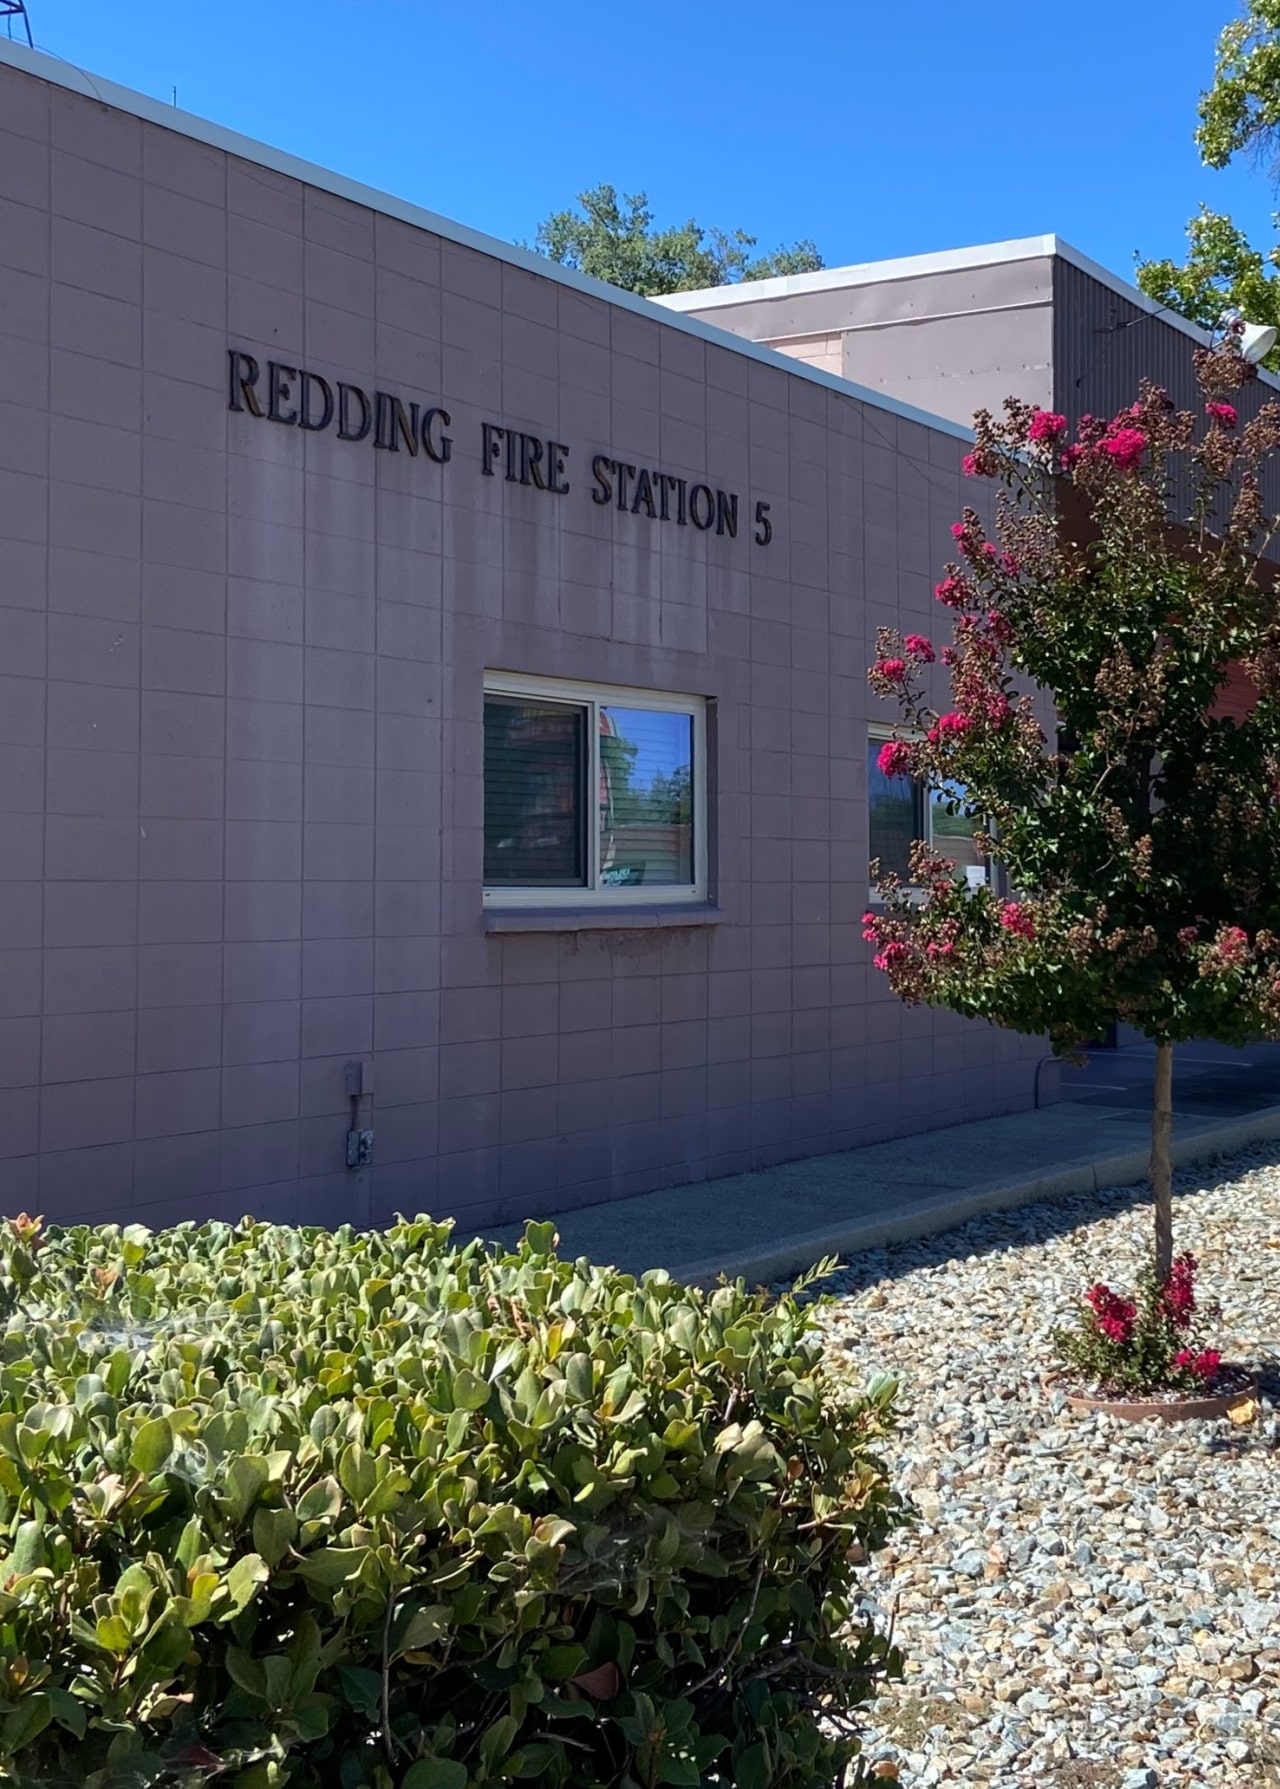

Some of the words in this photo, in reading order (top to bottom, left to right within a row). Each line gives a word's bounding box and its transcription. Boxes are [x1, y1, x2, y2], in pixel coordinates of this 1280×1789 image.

[228, 350, 453, 464] REDDING
[481, 422, 570, 494] FIRE
[592, 455, 738, 538] STATION
[755, 501, 772, 546] 5
